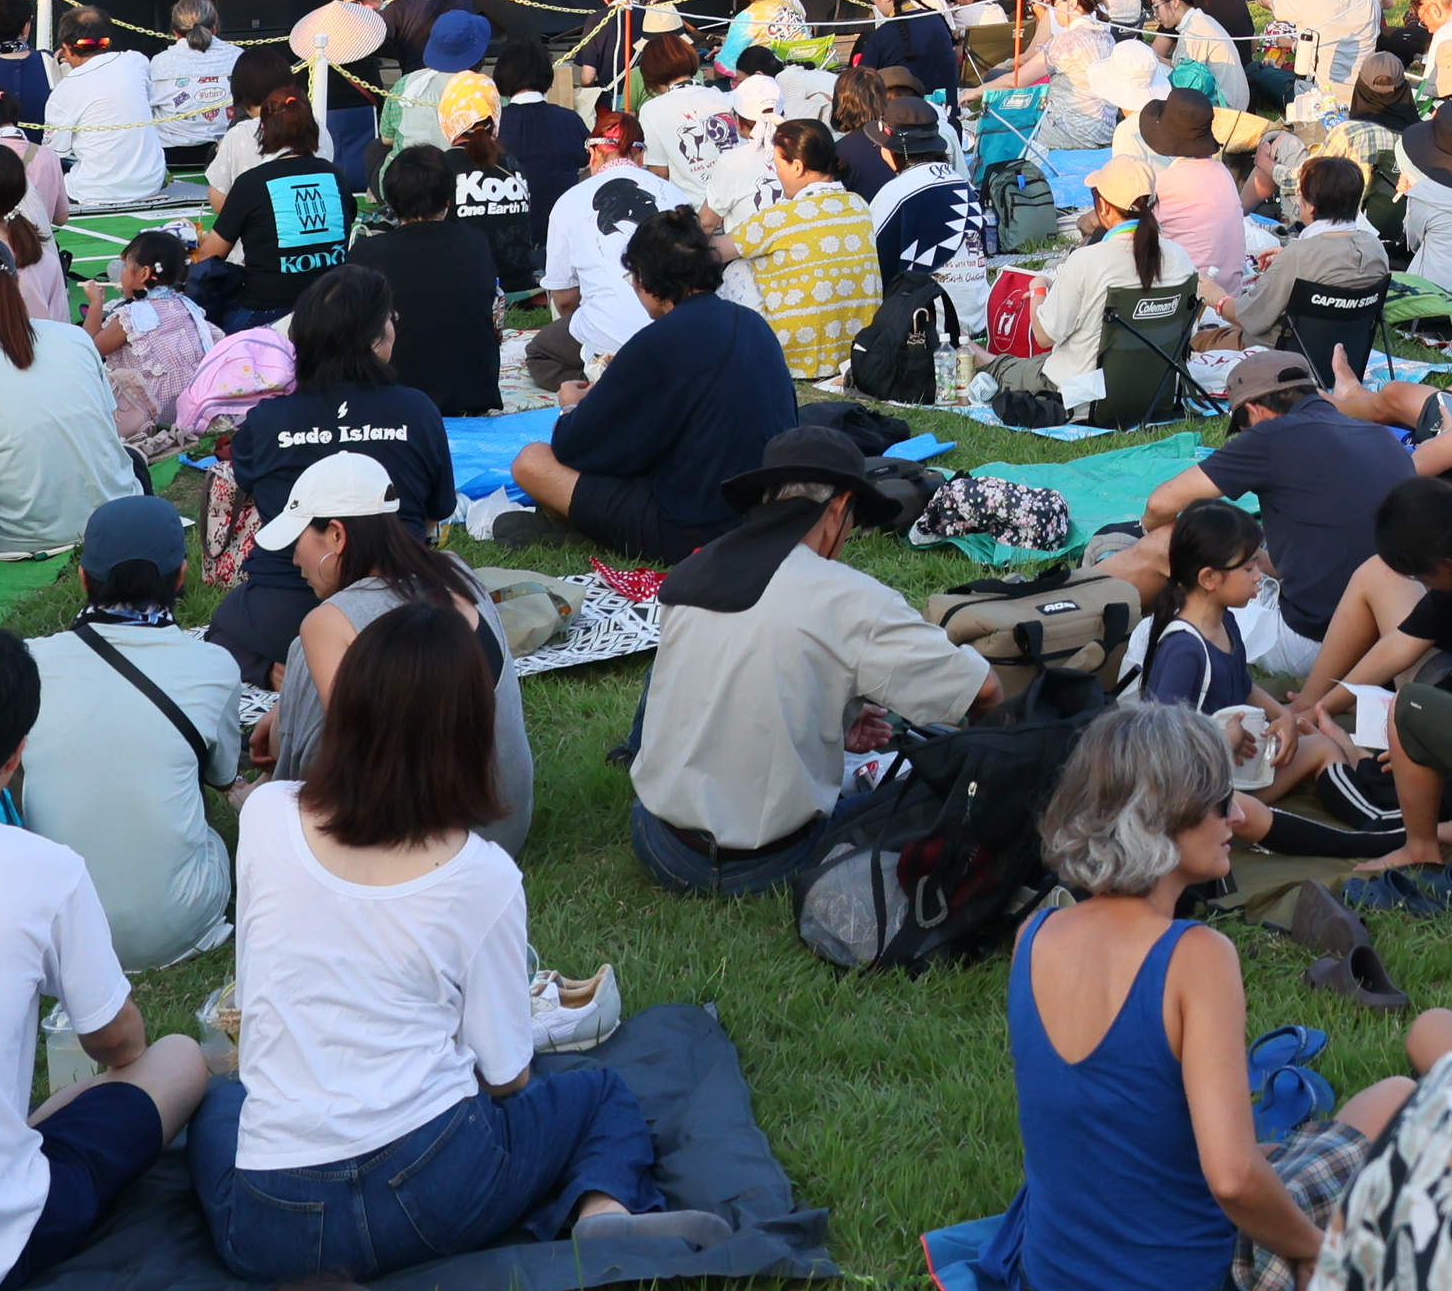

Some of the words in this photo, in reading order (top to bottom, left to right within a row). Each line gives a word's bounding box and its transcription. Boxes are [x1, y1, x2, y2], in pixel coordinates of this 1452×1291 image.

[456, 171, 530, 206] Kod
[457, 204, 486, 218] One
[487, 201, 520, 215] Earth
[1138, 301, 1172, 314] Coleman
[1311, 294, 1359, 309] CAPTAIN
[278, 427, 332, 449] Sado
[338, 424, 408, 443] Island
